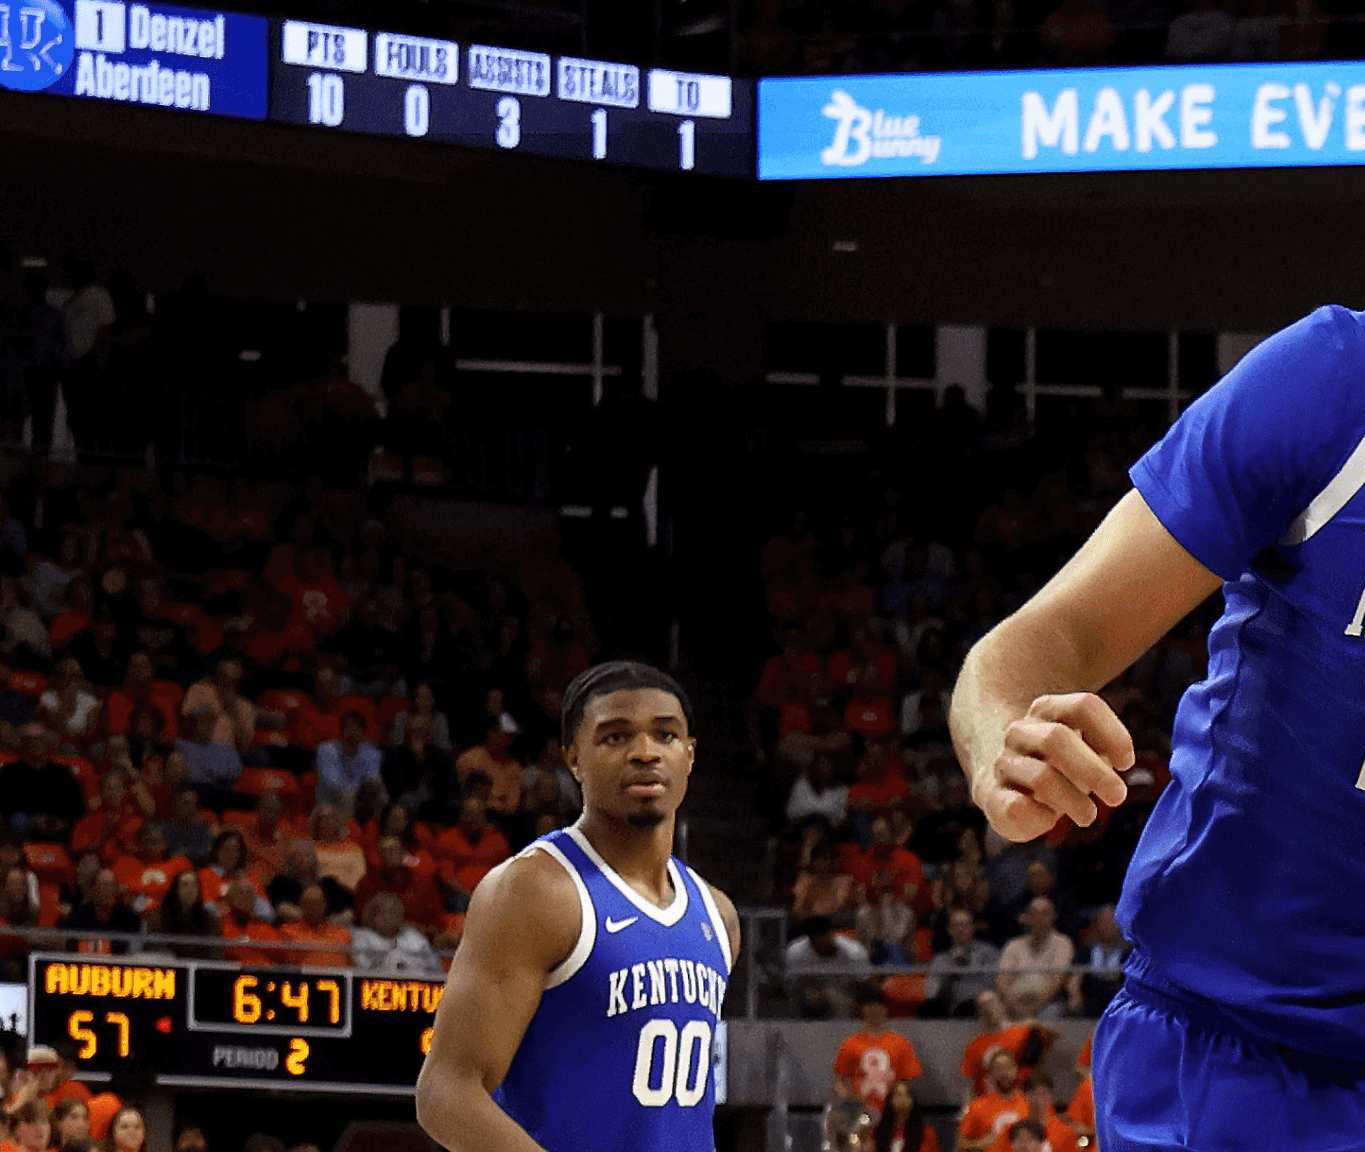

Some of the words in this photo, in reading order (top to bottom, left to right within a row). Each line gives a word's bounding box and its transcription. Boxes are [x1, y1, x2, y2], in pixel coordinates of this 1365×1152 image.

[129, 3, 225, 60] Denzel
[307, 30, 346, 66] PTS
[76, 51, 210, 111] Aberdeen
[386, 40, 447, 76] FOULS
[472, 51, 547, 92] ASSISTS
[564, 63, 637, 101] STEALS
[306, 71, 345, 127] 10
[403, 84, 431, 137] 0
[674, 79, 702, 111] TO
[821, 88, 921, 141] Blue
[495, 96, 521, 149] 3
[590, 108, 608, 160] 1
[677, 119, 696, 171] 1
[1020, 83, 1218, 160] MAKE
[45, 963, 175, 999] AUBURN
[233, 975, 340, 1024] 6:47
[68, 1011, 129, 1059] 57
[213, 1044, 278, 1070] PERIOD
[285, 1038, 310, 1075] 2
[632, 1019, 711, 1107] 00
